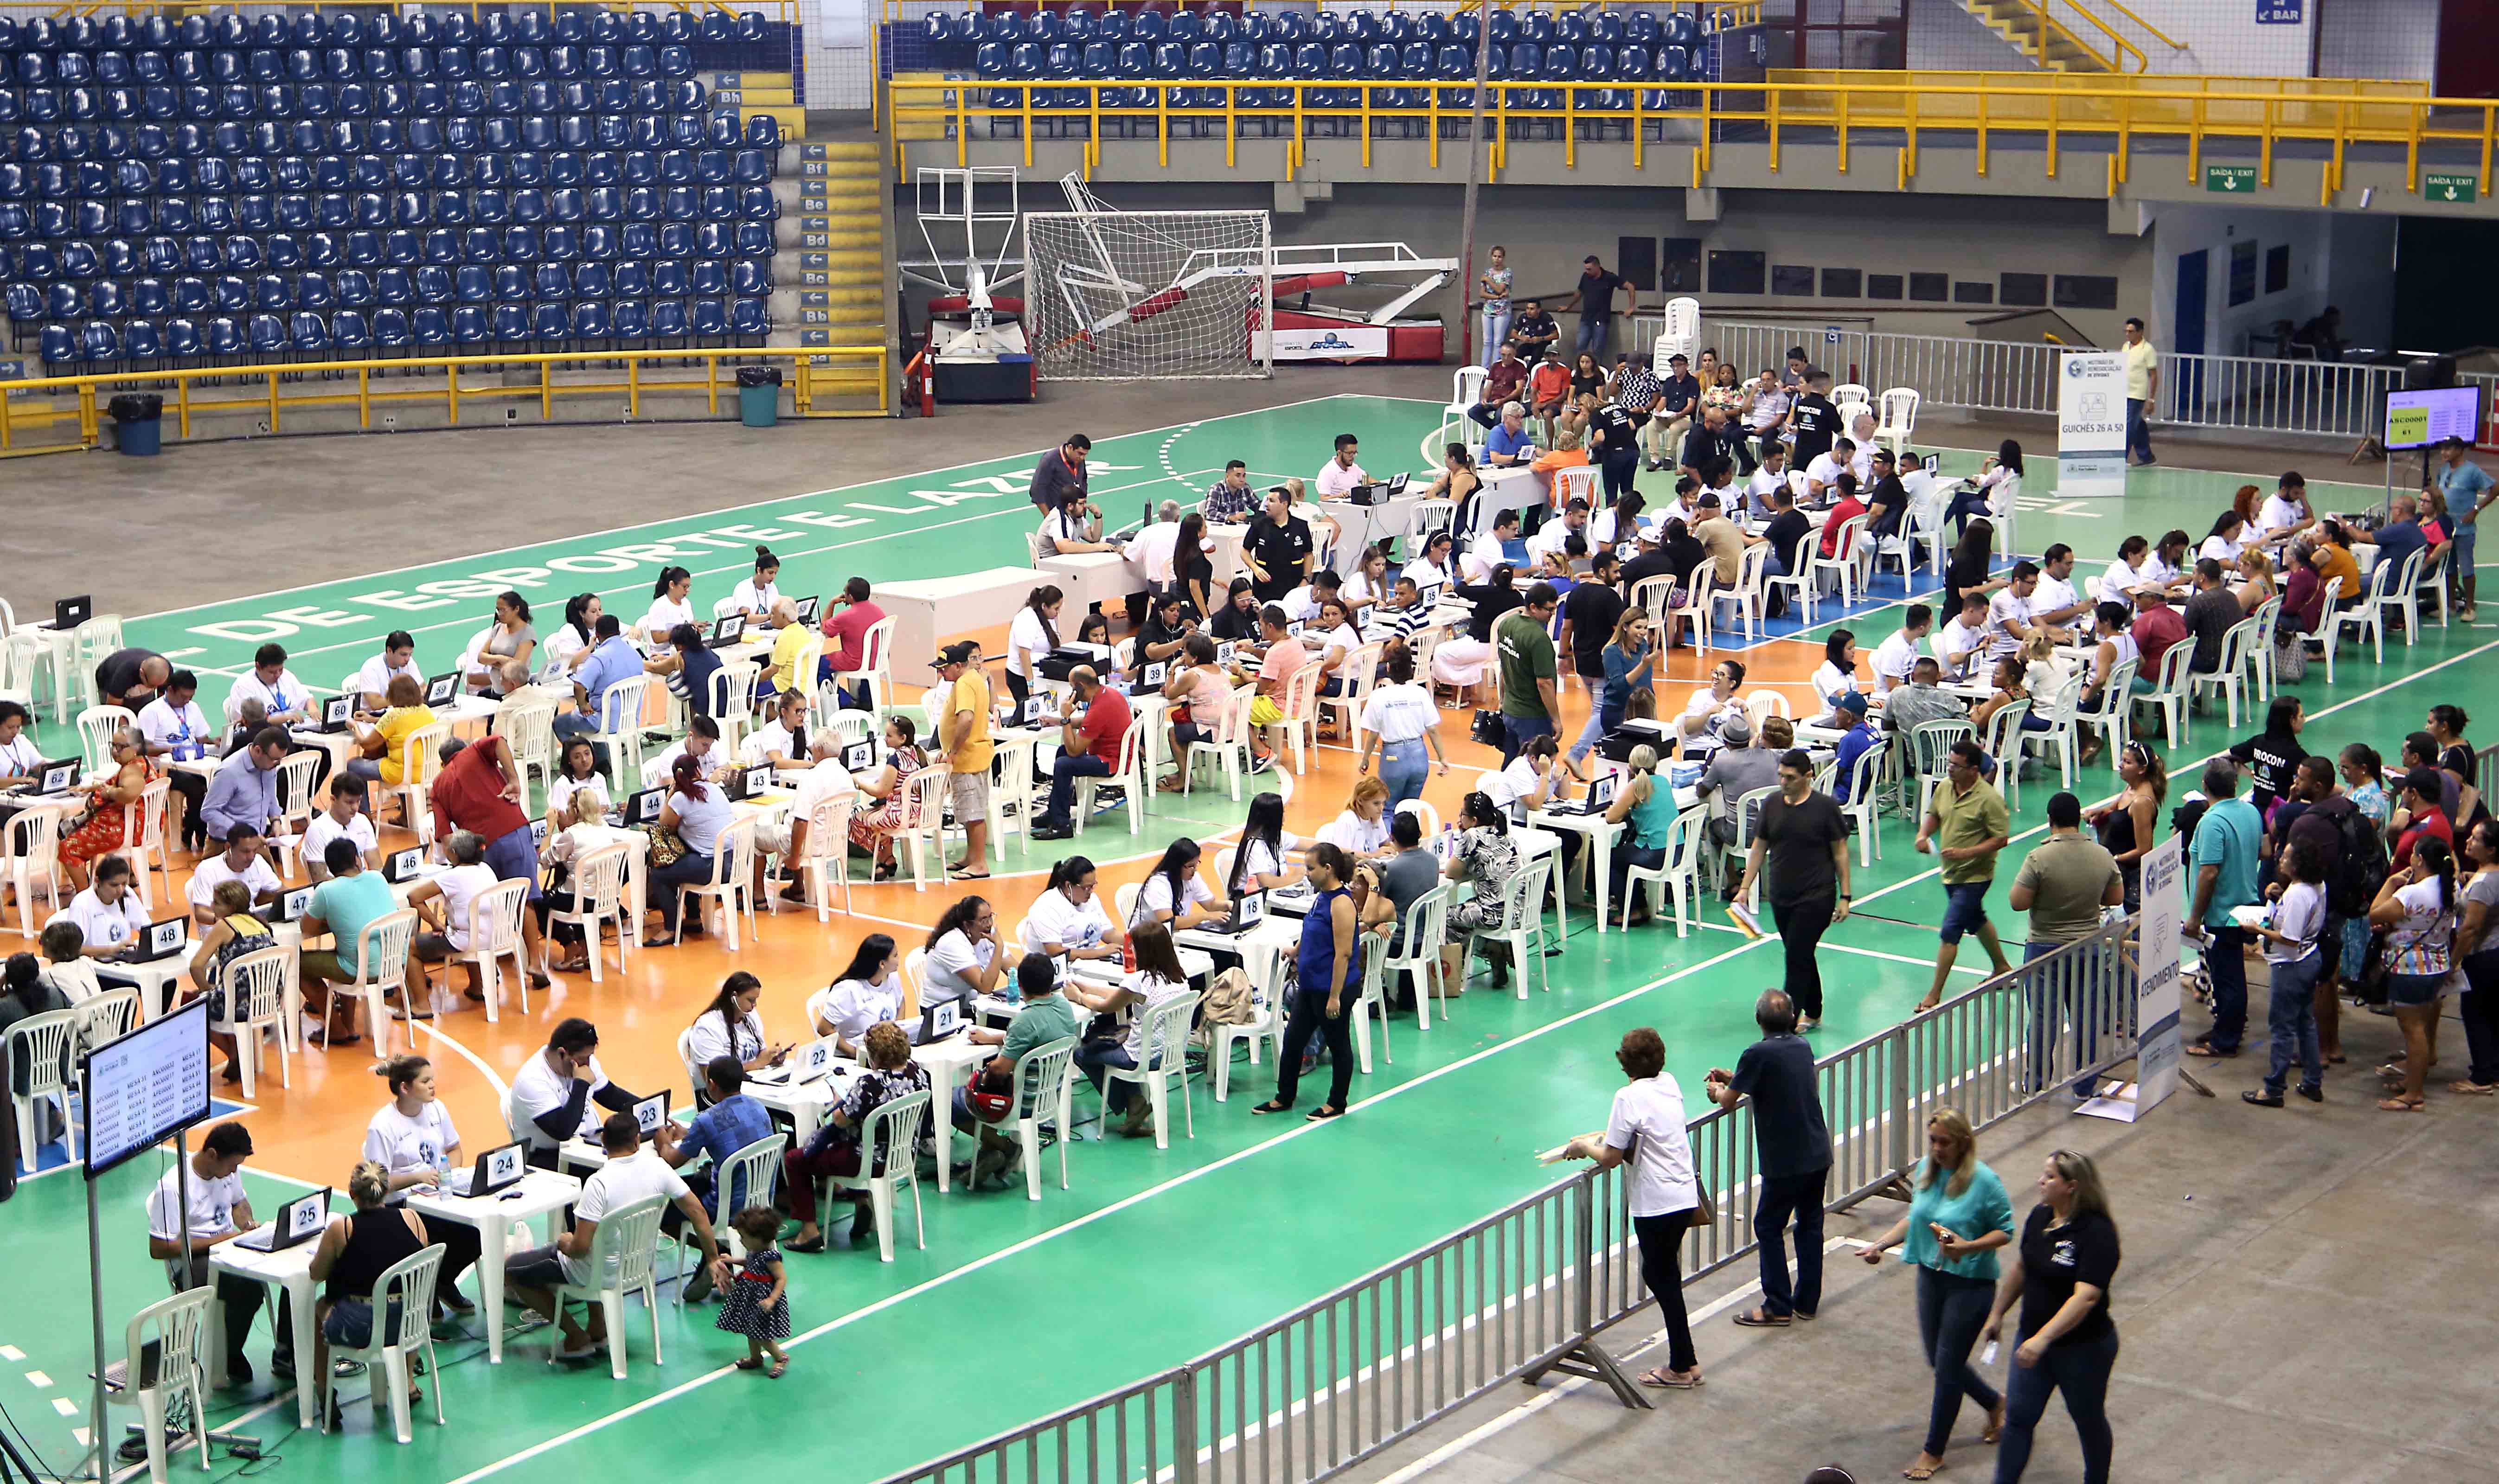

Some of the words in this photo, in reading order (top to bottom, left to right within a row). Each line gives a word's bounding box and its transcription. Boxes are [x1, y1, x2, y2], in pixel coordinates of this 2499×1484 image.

[2274, 12, 2298, 20] BAR
[722, 92, 740, 103] Bh
[807, 163, 822, 174] Bf
[806, 199, 824, 210] Be
[807, 234, 825, 245] Bd
[806, 273, 824, 284] Bc
[807, 311, 827, 323] Bb
[186, 606, 375, 642] DE
[348, 525, 807, 611] ESPORTE
[776, 511, 875, 528] E
[1428, 592, 1435, 601] 35
[1362, 611, 1369, 620] 36
[727, 623, 735, 631] 56
[1291, 628, 1299, 637] 37
[1222, 648, 1230, 658] 38
[1151, 669, 1160, 679] 39
[436, 685, 446, 695] 59
[335, 705, 346, 715] 60
[1030, 703, 1039, 713] 40
[855, 750, 865, 761] 42
[2253, 748, 2286, 768] PROCON
[51, 773, 64, 783] 62
[753, 776, 764, 787] 43
[1602, 785, 1610, 797] 14
[647, 797, 659, 809] 44
[534, 826, 546, 838] 45
[1434, 842, 1443, 854] 16
[403, 857, 416, 869] 46
[293, 896, 306, 909] 47
[1247, 901, 1257, 914] 18
[160, 929, 175, 942] 48
[2140, 960, 2180, 1000] ATENDIMENTO
[941, 1011, 952, 1026] 21
[813, 1050, 825, 1065] 22
[641, 1107, 656, 1124] 23
[497, 1156, 513, 1173] 24
[299, 1207, 315, 1225] 25
